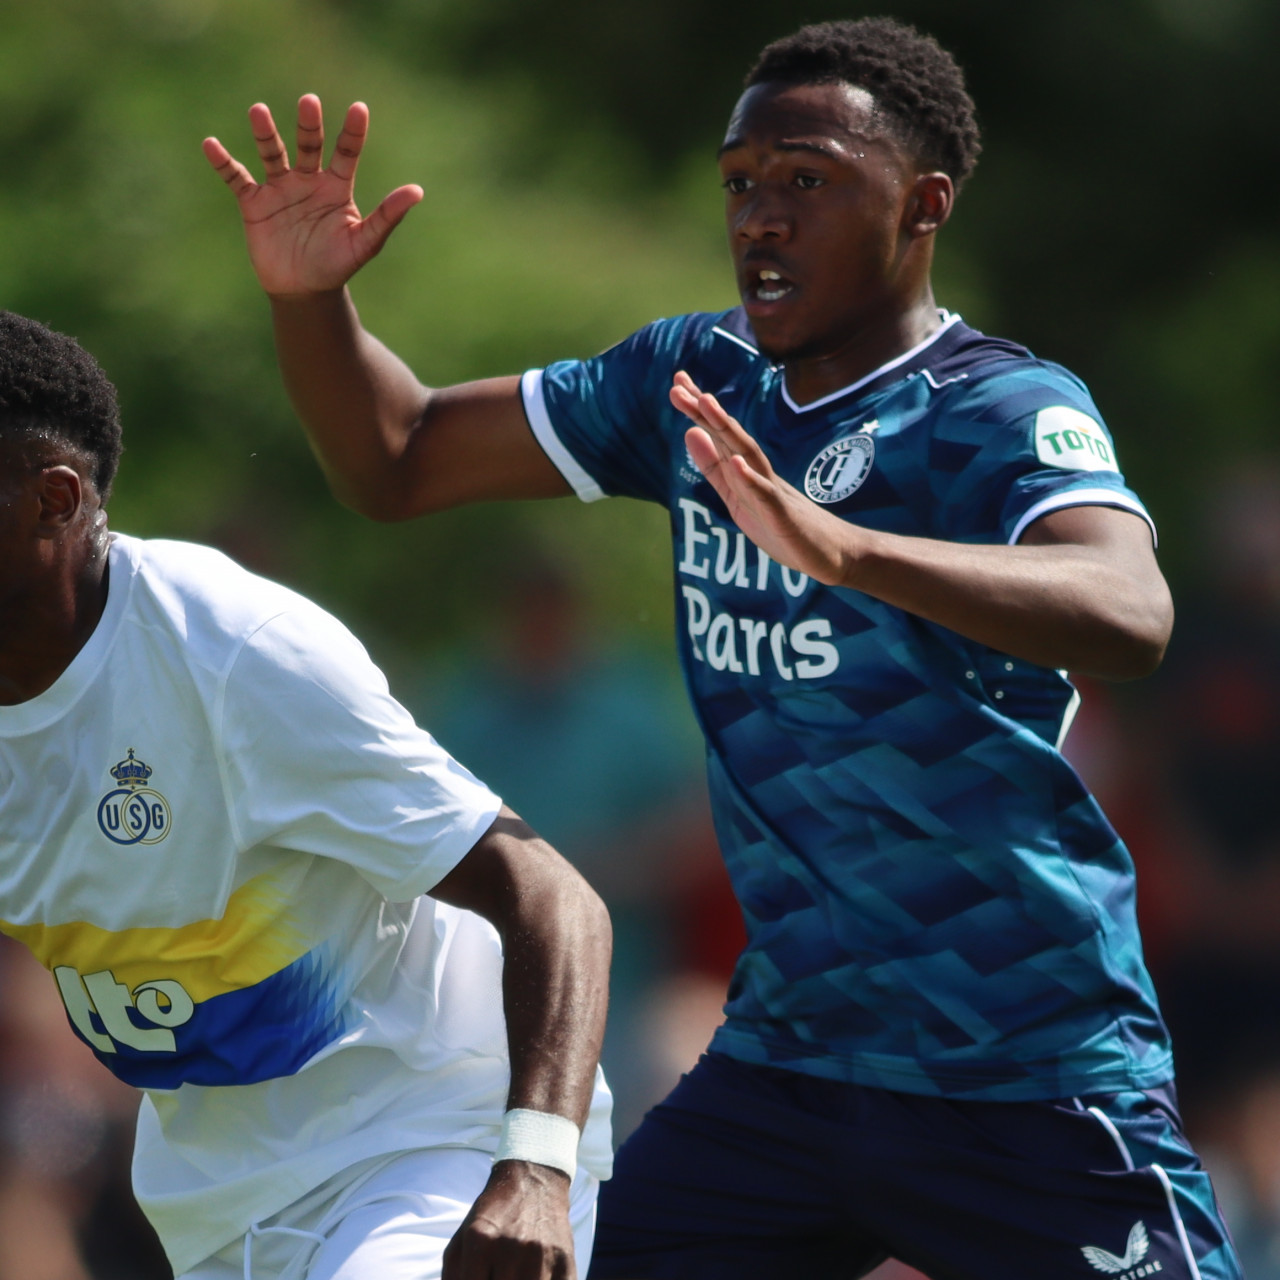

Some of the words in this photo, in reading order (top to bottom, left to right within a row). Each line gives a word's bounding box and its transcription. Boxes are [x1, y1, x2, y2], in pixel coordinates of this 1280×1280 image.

[1042, 429, 1110, 464] TOTO
[682, 585, 839, 681] Parcs
[106, 803, 164, 831] USG
